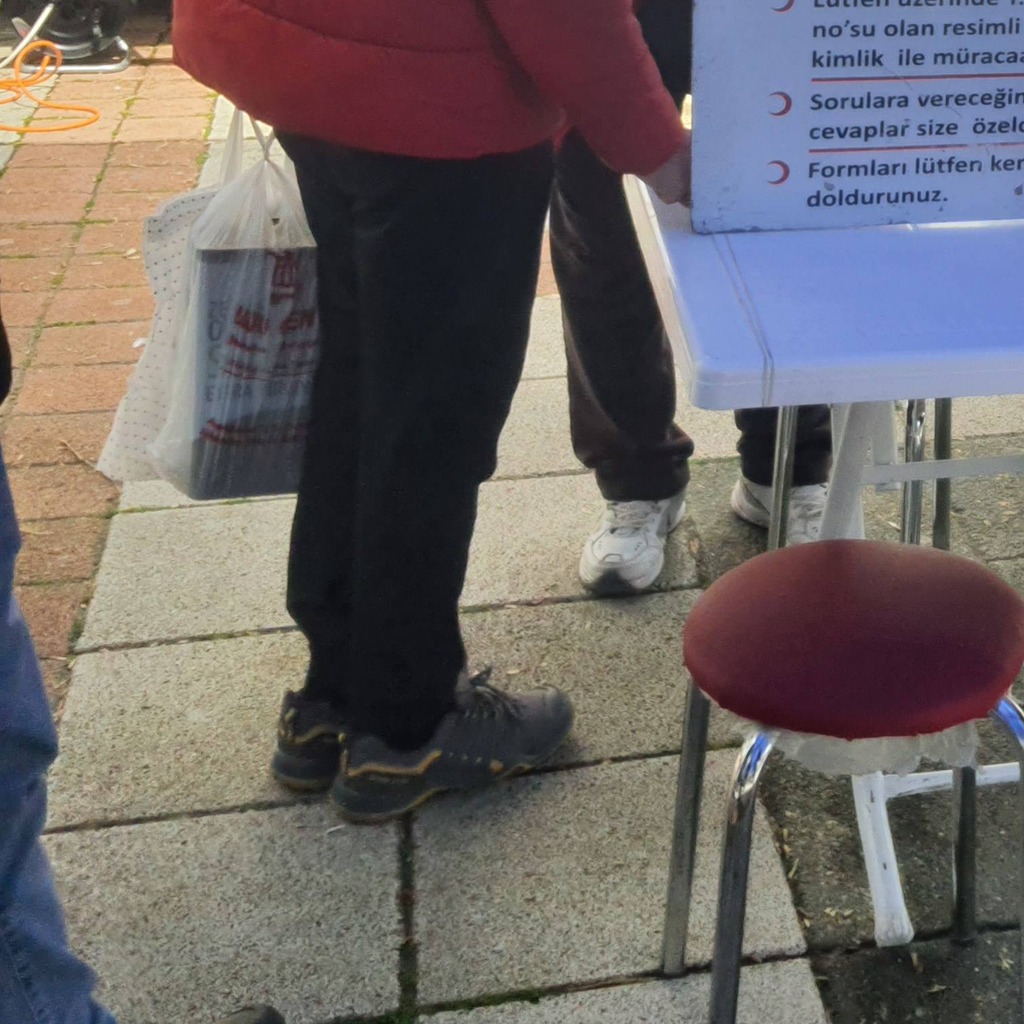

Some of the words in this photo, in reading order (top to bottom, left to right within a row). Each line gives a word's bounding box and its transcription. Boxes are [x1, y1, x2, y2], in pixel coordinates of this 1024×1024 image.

[884, 20, 935, 37] olan
[943, 18, 1020, 36] resimli
[812, 50, 883, 67] kimlik
[898, 48, 925, 66] ile
[810, 92, 909, 111] Sorulara
[810, 121, 909, 142] cevaplar
[917, 120, 958, 136] size
[808, 159, 907, 178] Formları
[915, 157, 982, 175] lütfen
[807, 189, 948, 207] doldurunuz.
